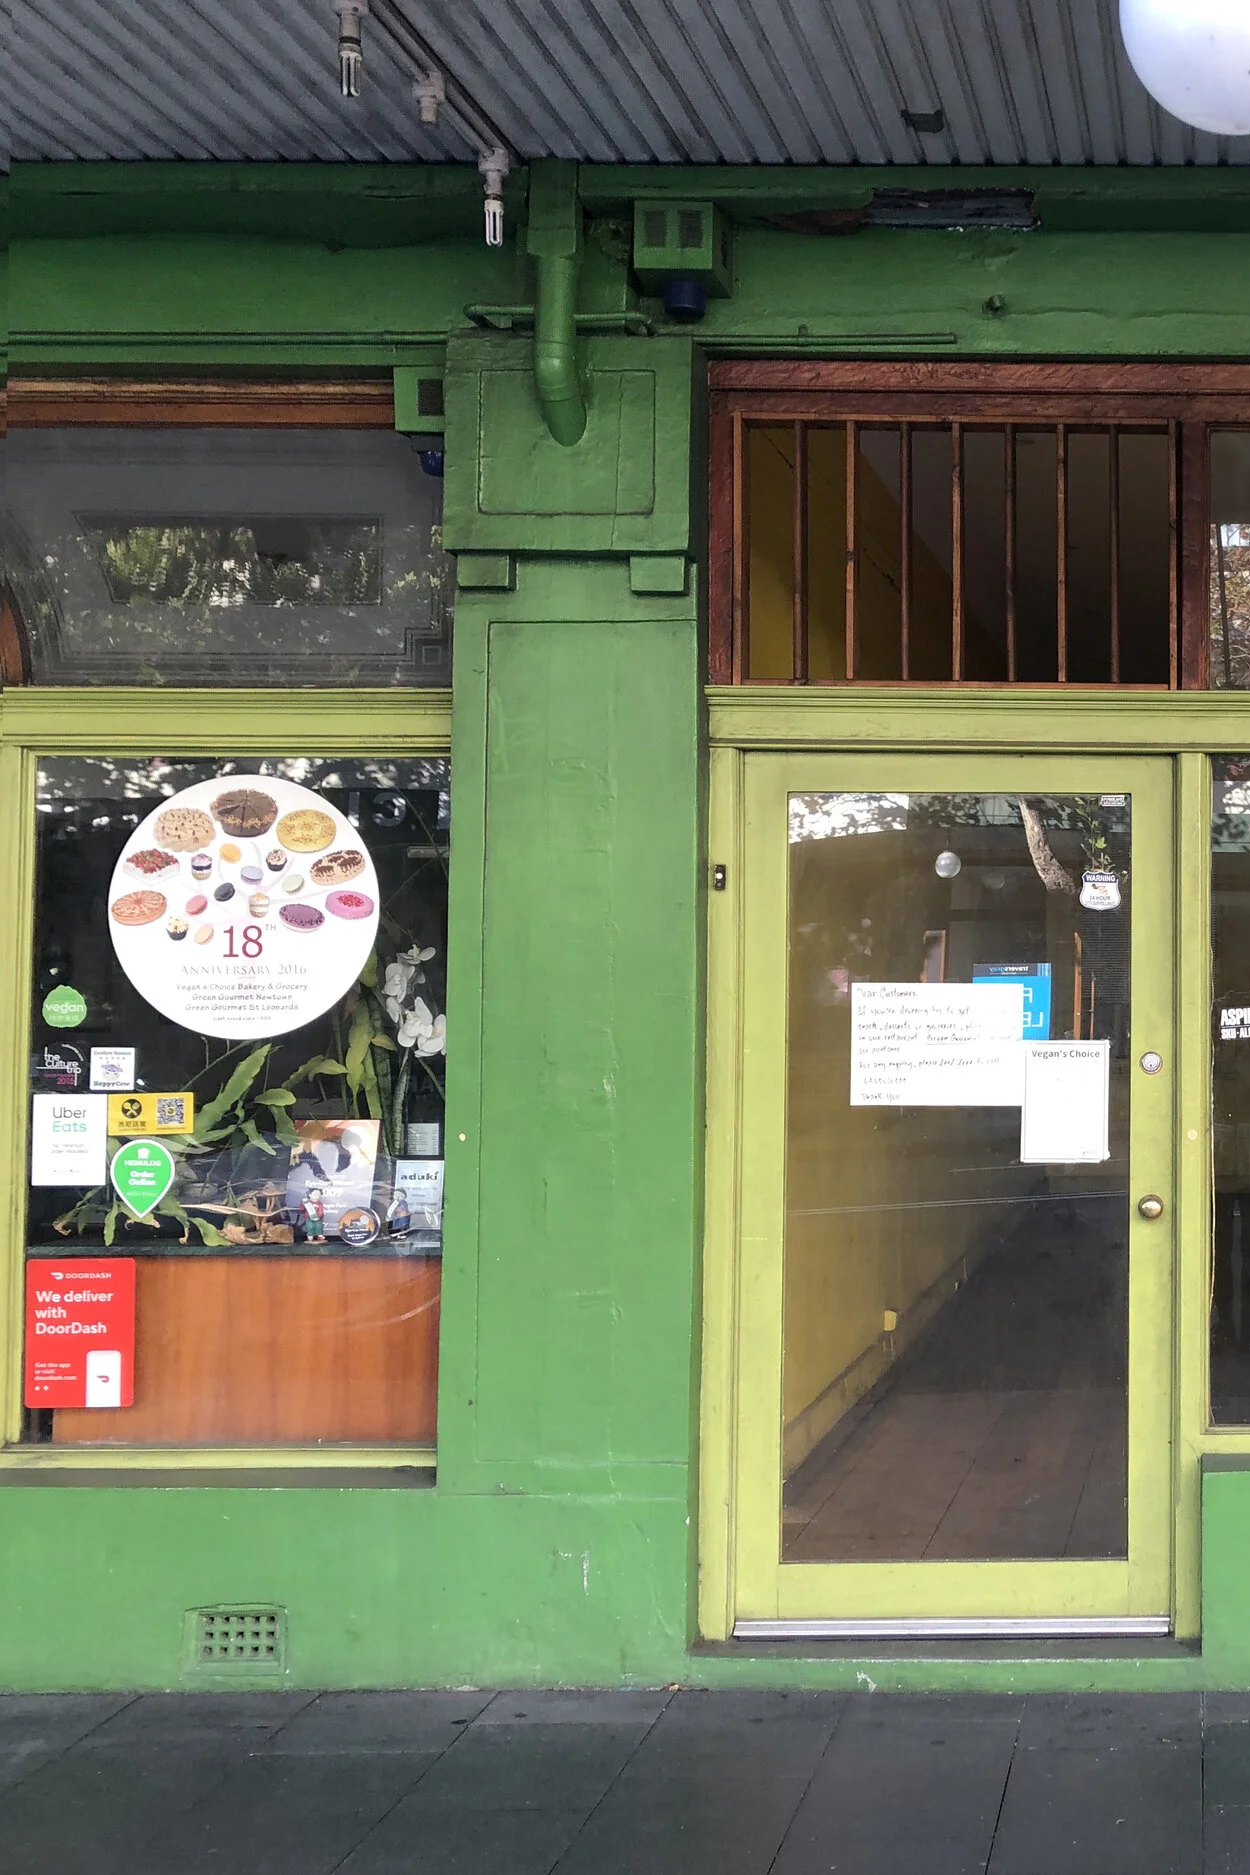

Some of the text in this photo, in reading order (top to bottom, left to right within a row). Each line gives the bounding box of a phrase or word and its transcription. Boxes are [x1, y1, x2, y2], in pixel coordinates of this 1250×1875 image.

[182, 964, 307, 975] ANNIVERSARY 2016
[237, 983, 265, 991] Bakery
[275, 983, 308, 991] Grocery
[880, 987, 917, 999] Customers
[45, 1002, 84, 1014] vegan
[1031, 1050, 1100, 1059] Vegan's Choice
[45, 1059, 79, 1068] Culture
[52, 1107, 87, 1119] Uber
[52, 1121, 88, 1133] Eats
[130, 1170, 156, 1178] Order
[128, 1178, 156, 1186] Online
[35, 1290, 114, 1303] We deliver
[34, 1306, 67, 1319] with
[35, 1322, 107, 1335] DoorDash
